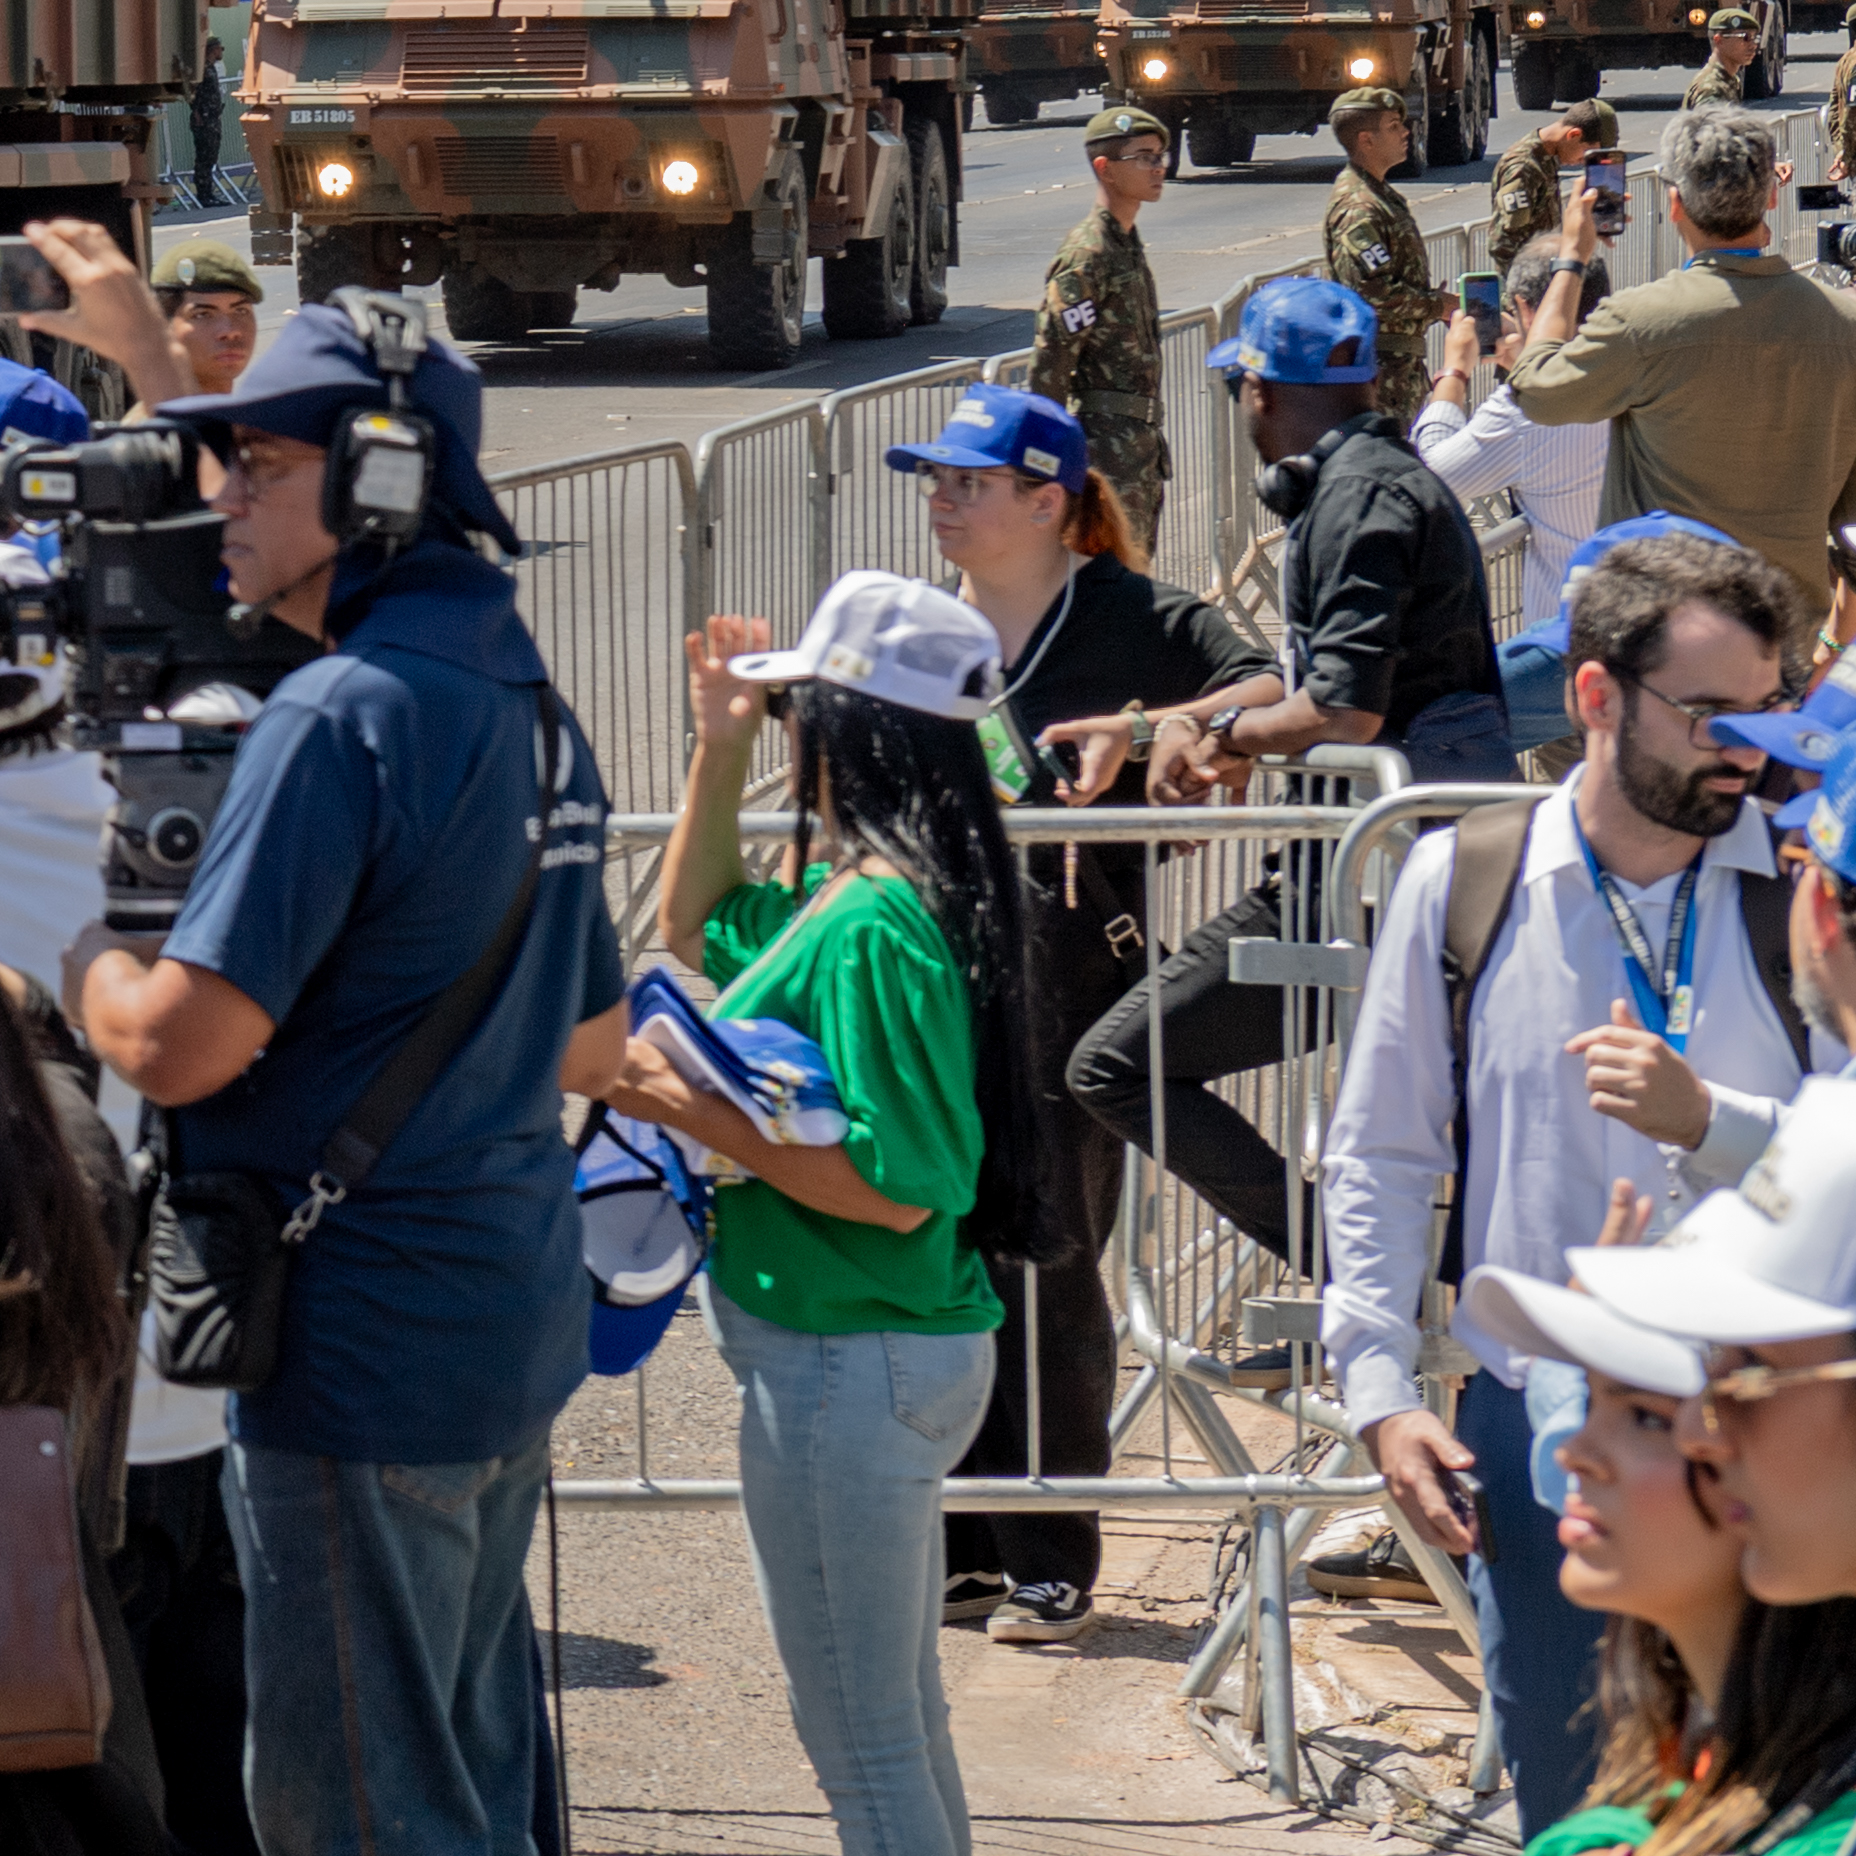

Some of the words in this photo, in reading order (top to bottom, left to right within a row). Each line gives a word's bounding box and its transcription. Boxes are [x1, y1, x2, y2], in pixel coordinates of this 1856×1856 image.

[290, 110, 312, 124] EB
[314, 109, 355, 123] 51805
[1503, 190, 1529, 212] PE
[1360, 244, 1391, 271] PE
[1062, 299, 1097, 333] PE
